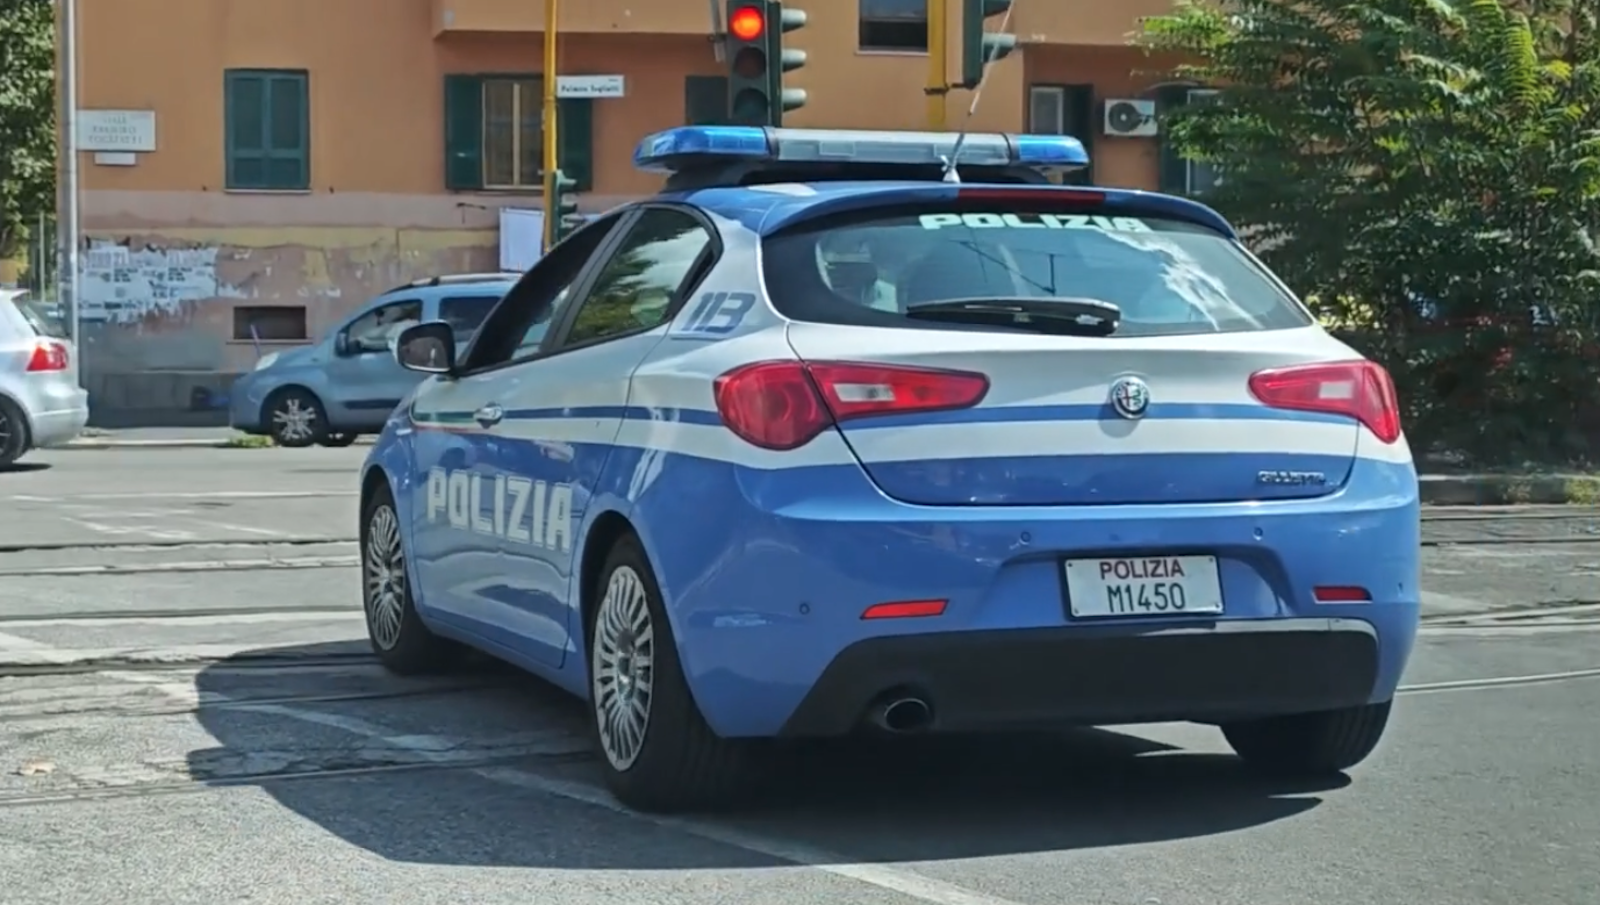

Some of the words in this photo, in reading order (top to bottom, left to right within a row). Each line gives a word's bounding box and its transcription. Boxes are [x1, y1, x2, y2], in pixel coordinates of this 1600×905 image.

[918, 213, 1153, 233] POLIZIA
[680, 291, 756, 334] 113
[427, 465, 573, 553] POLIZIA
[1100, 559, 1185, 580] POLIZIA
[1106, 582, 1186, 613] M1450
